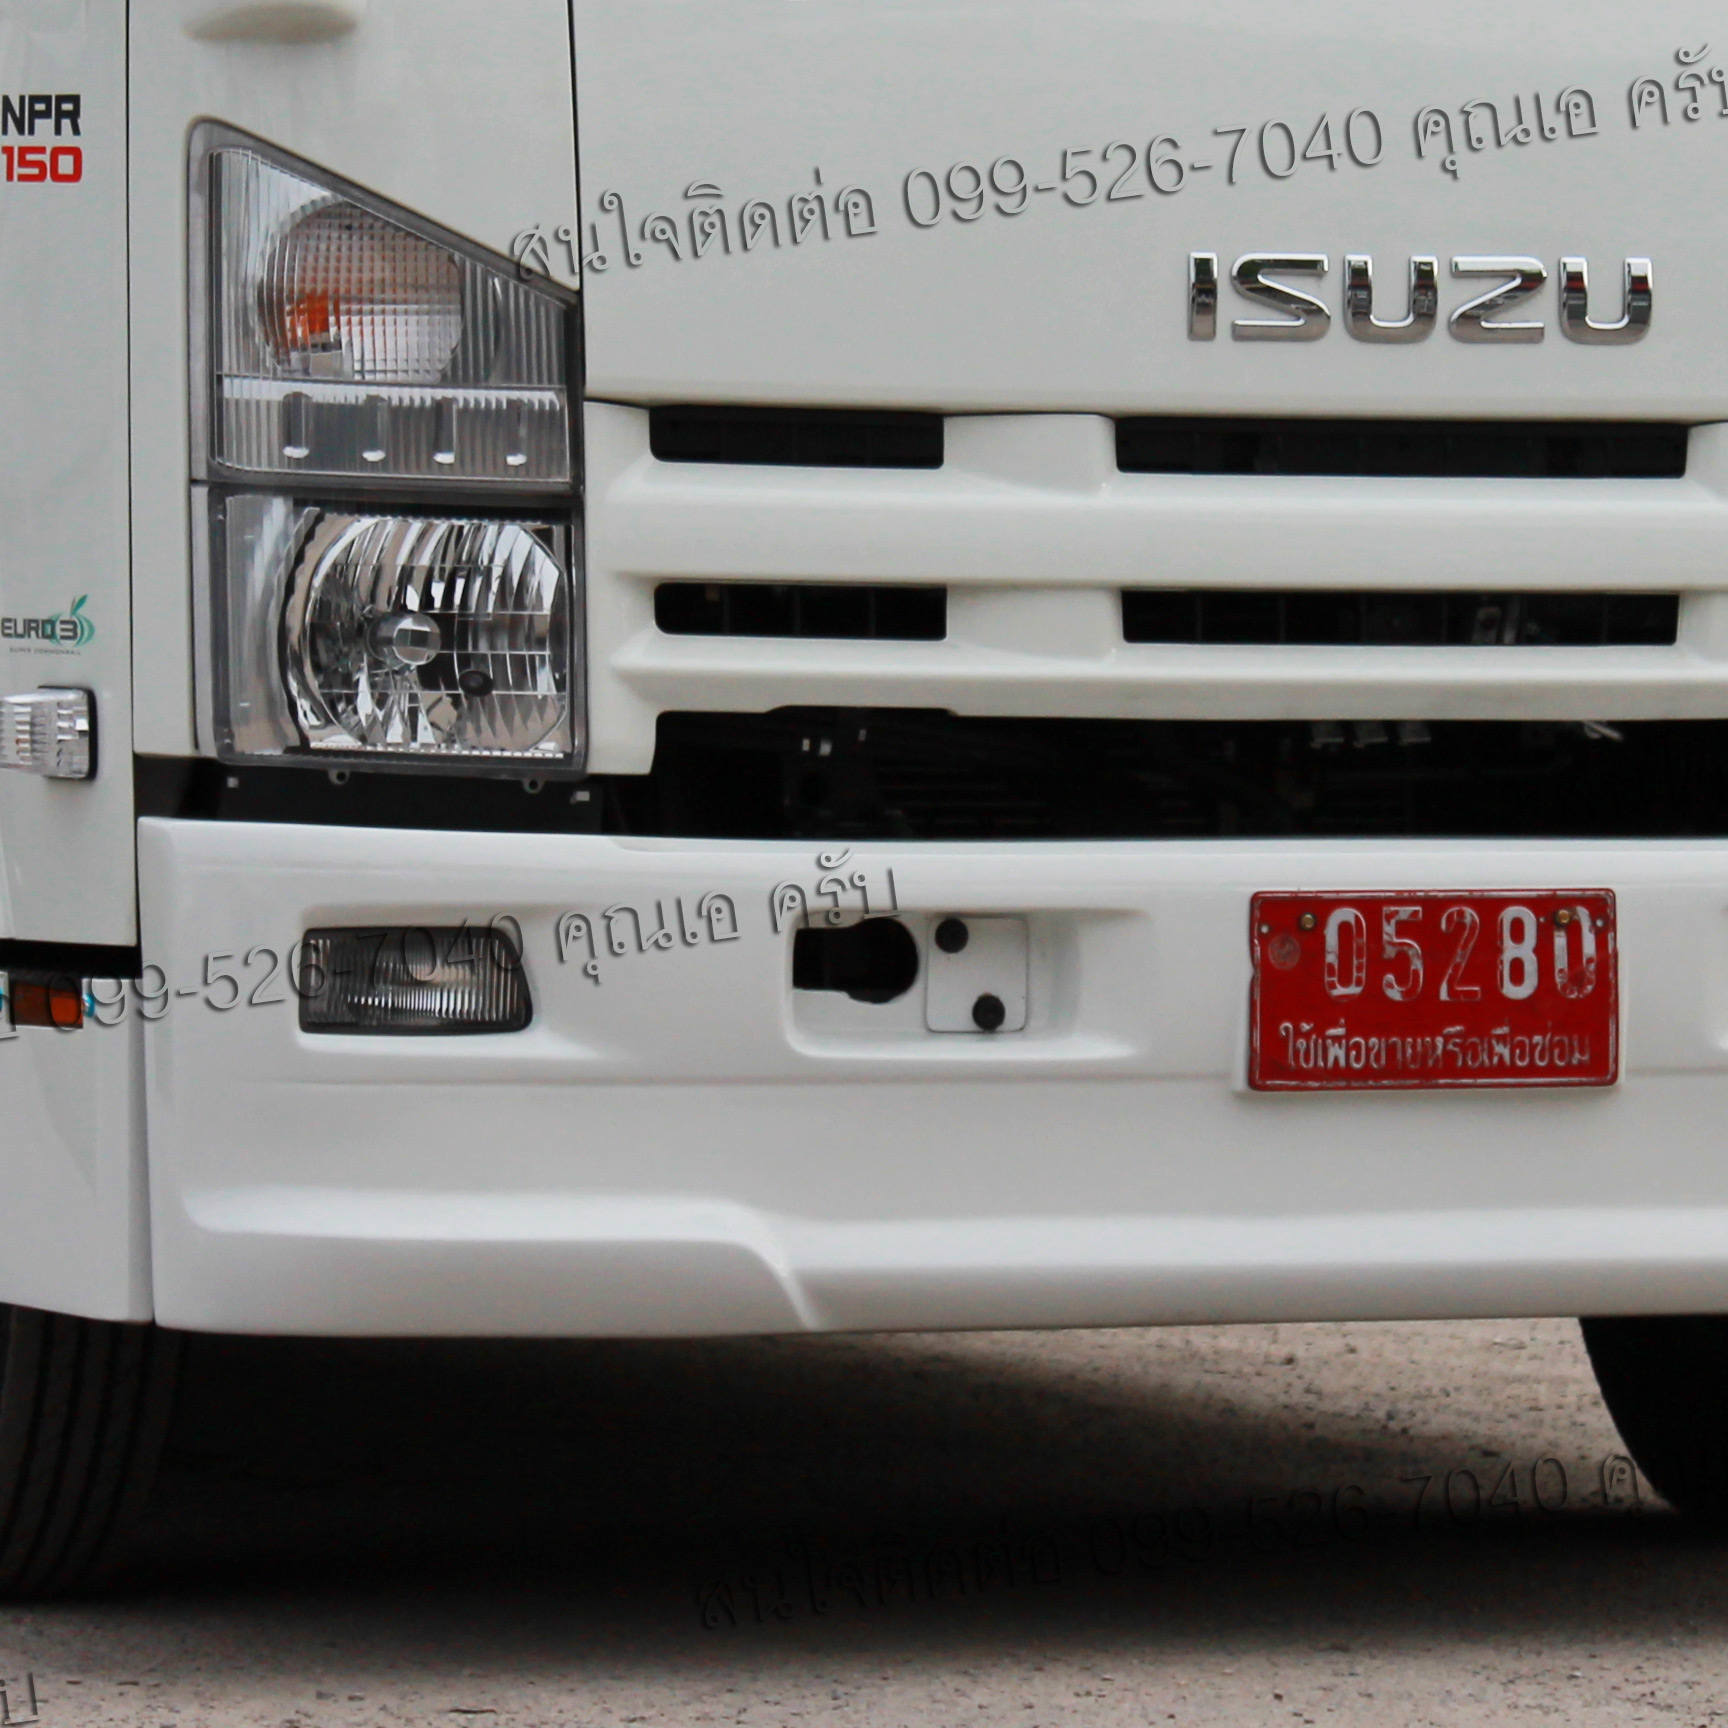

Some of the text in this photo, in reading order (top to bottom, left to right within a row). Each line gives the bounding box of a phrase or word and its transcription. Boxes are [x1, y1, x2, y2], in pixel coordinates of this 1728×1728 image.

[1, 94, 82, 137] NPR
[1, 145, 83, 184] 150
[1186, 251, 1654, 345] ISUZU
